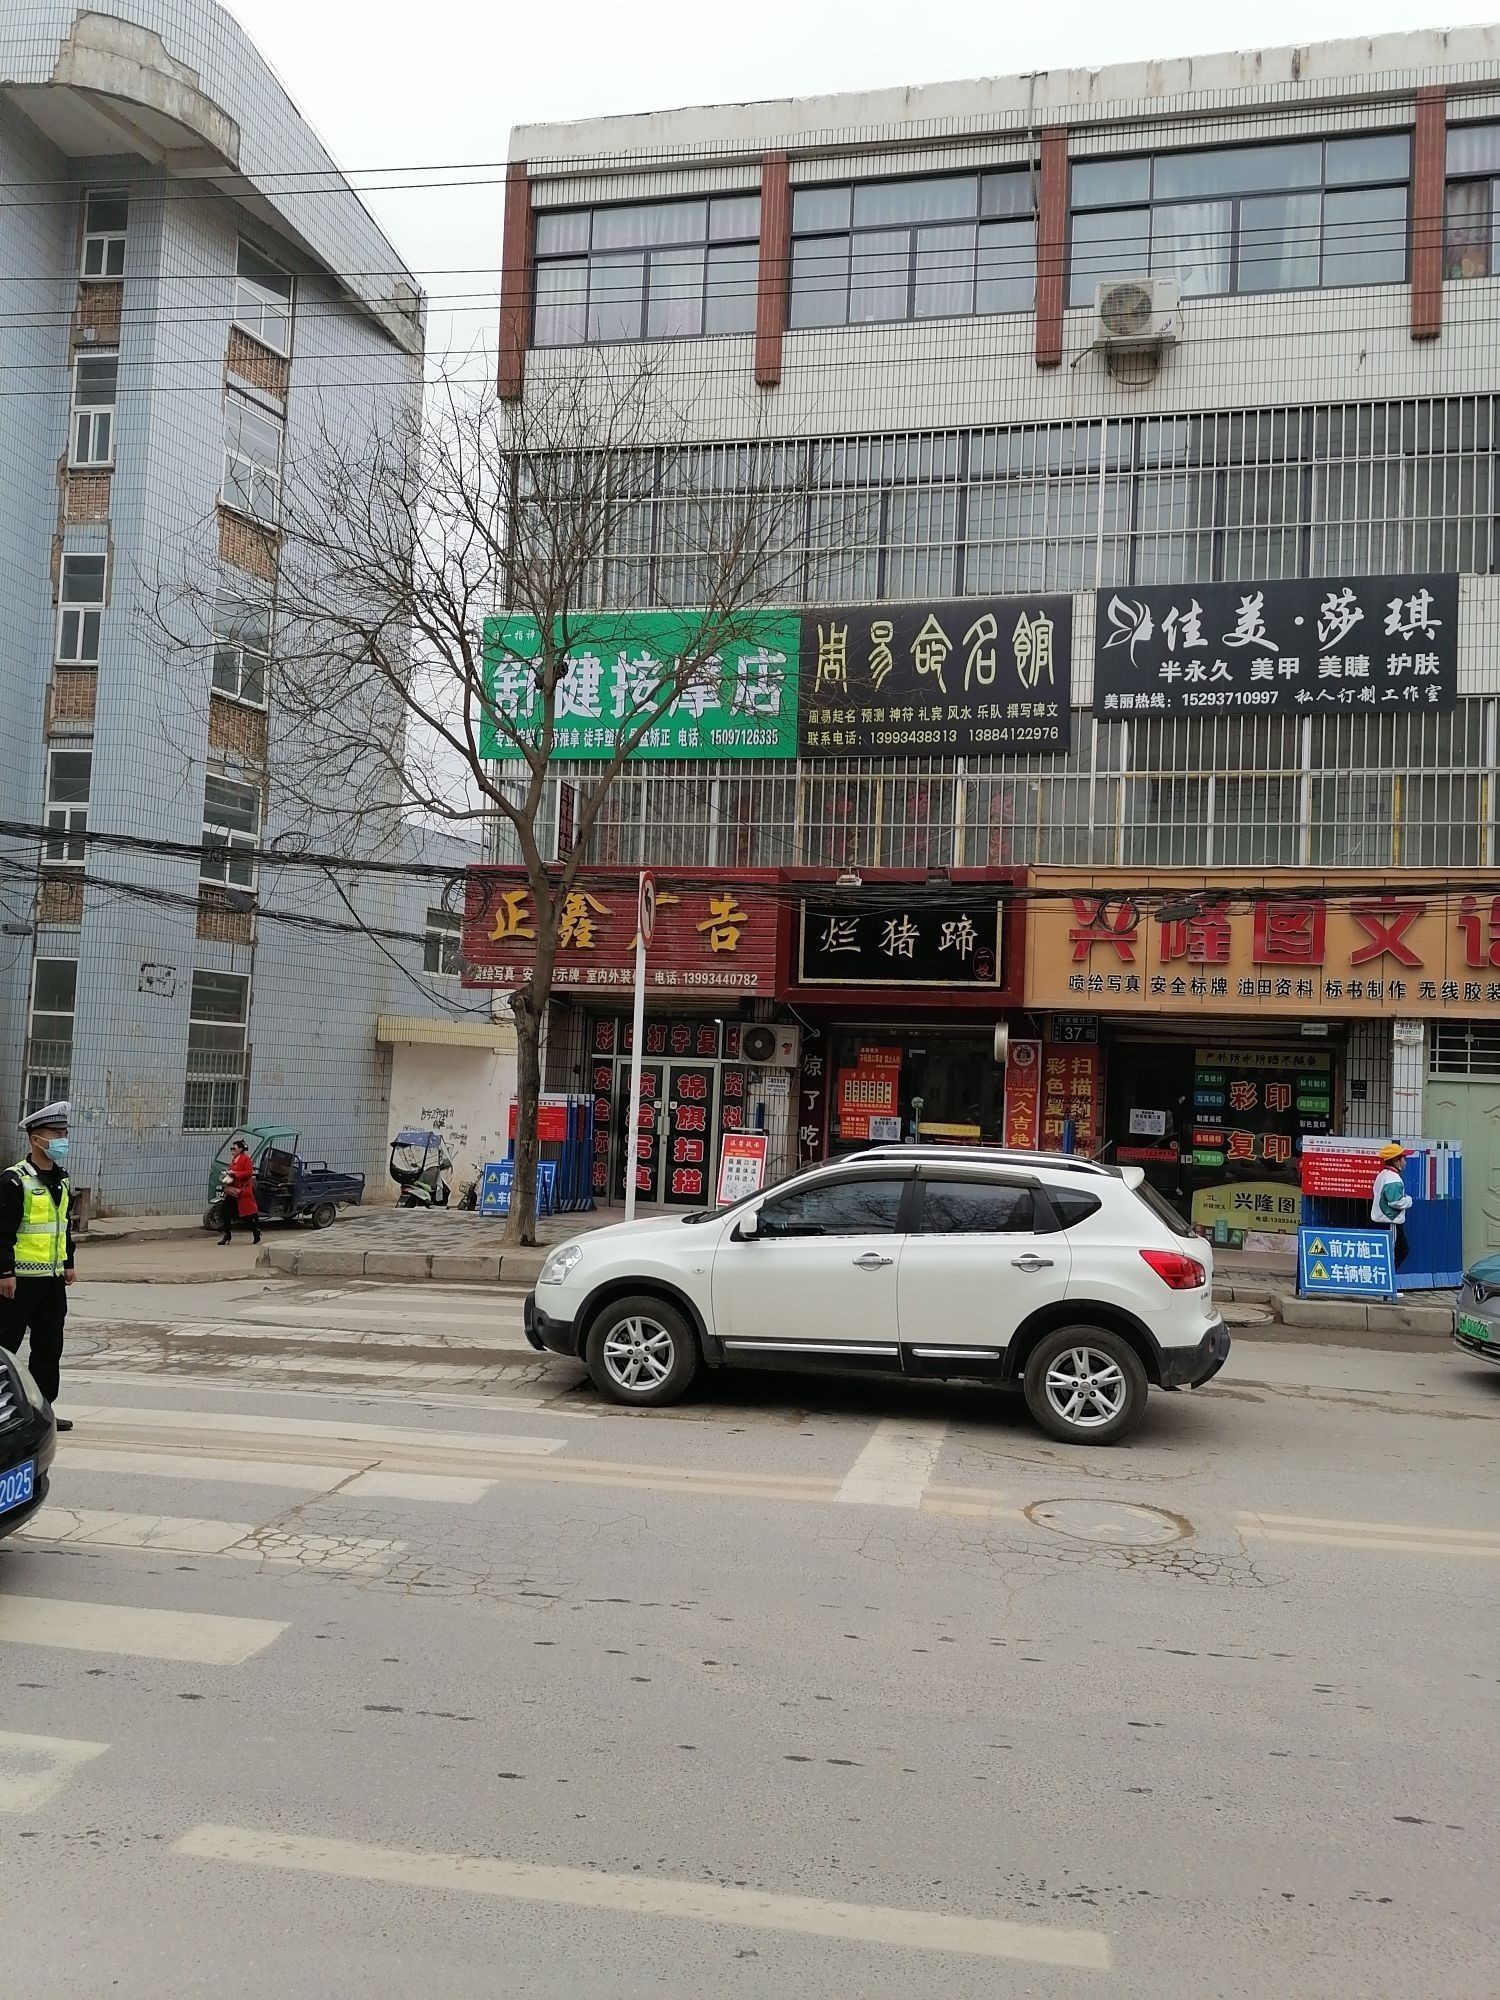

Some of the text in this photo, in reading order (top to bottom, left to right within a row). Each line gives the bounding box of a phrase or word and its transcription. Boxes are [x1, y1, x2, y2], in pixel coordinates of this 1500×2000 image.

[1159, 660, 1234, 683] 半永久
[1250, 657, 1300, 681] 美甲
[1387, 652, 1440, 676] 护肤
[493, 646, 788, 719] 舒健按摩店
[1182, 690, 1279, 706] 15293710997
[1294, 684, 1443, 704] 私人订制工作室
[808, 708, 856, 724] 周易起名
[861, 707, 885, 723] 预测
[918, 706, 943, 722] 礼宾
[947, 705, 972, 721] 风水
[977, 704, 1002, 719] 乐队
[1006, 702, 1059, 718] 撰写碑文
[710, 728, 779, 746] 15097126335
[870, 730, 957, 745] 13993438313
[969, 727, 1059, 742] 13884122976
[819, 912, 979, 961] 烂猪蹄
[586, 967, 638, 985] 室内外装
[1068, 974, 1500, 1002] 喷绘写真 安全标牌 油田资料 标书制作 无线胶装
[1064, 1026, 1083, 1041] 37
[1229, 1080, 1292, 1113] 彩印
[671, 1073, 707, 1194] 锦旗扫描
[1226, 1131, 1292, 1164] 复印
[1328, 1239, 1385, 1259] 前方施工
[1330, 1264, 1387, 1285] 车辆慢行
